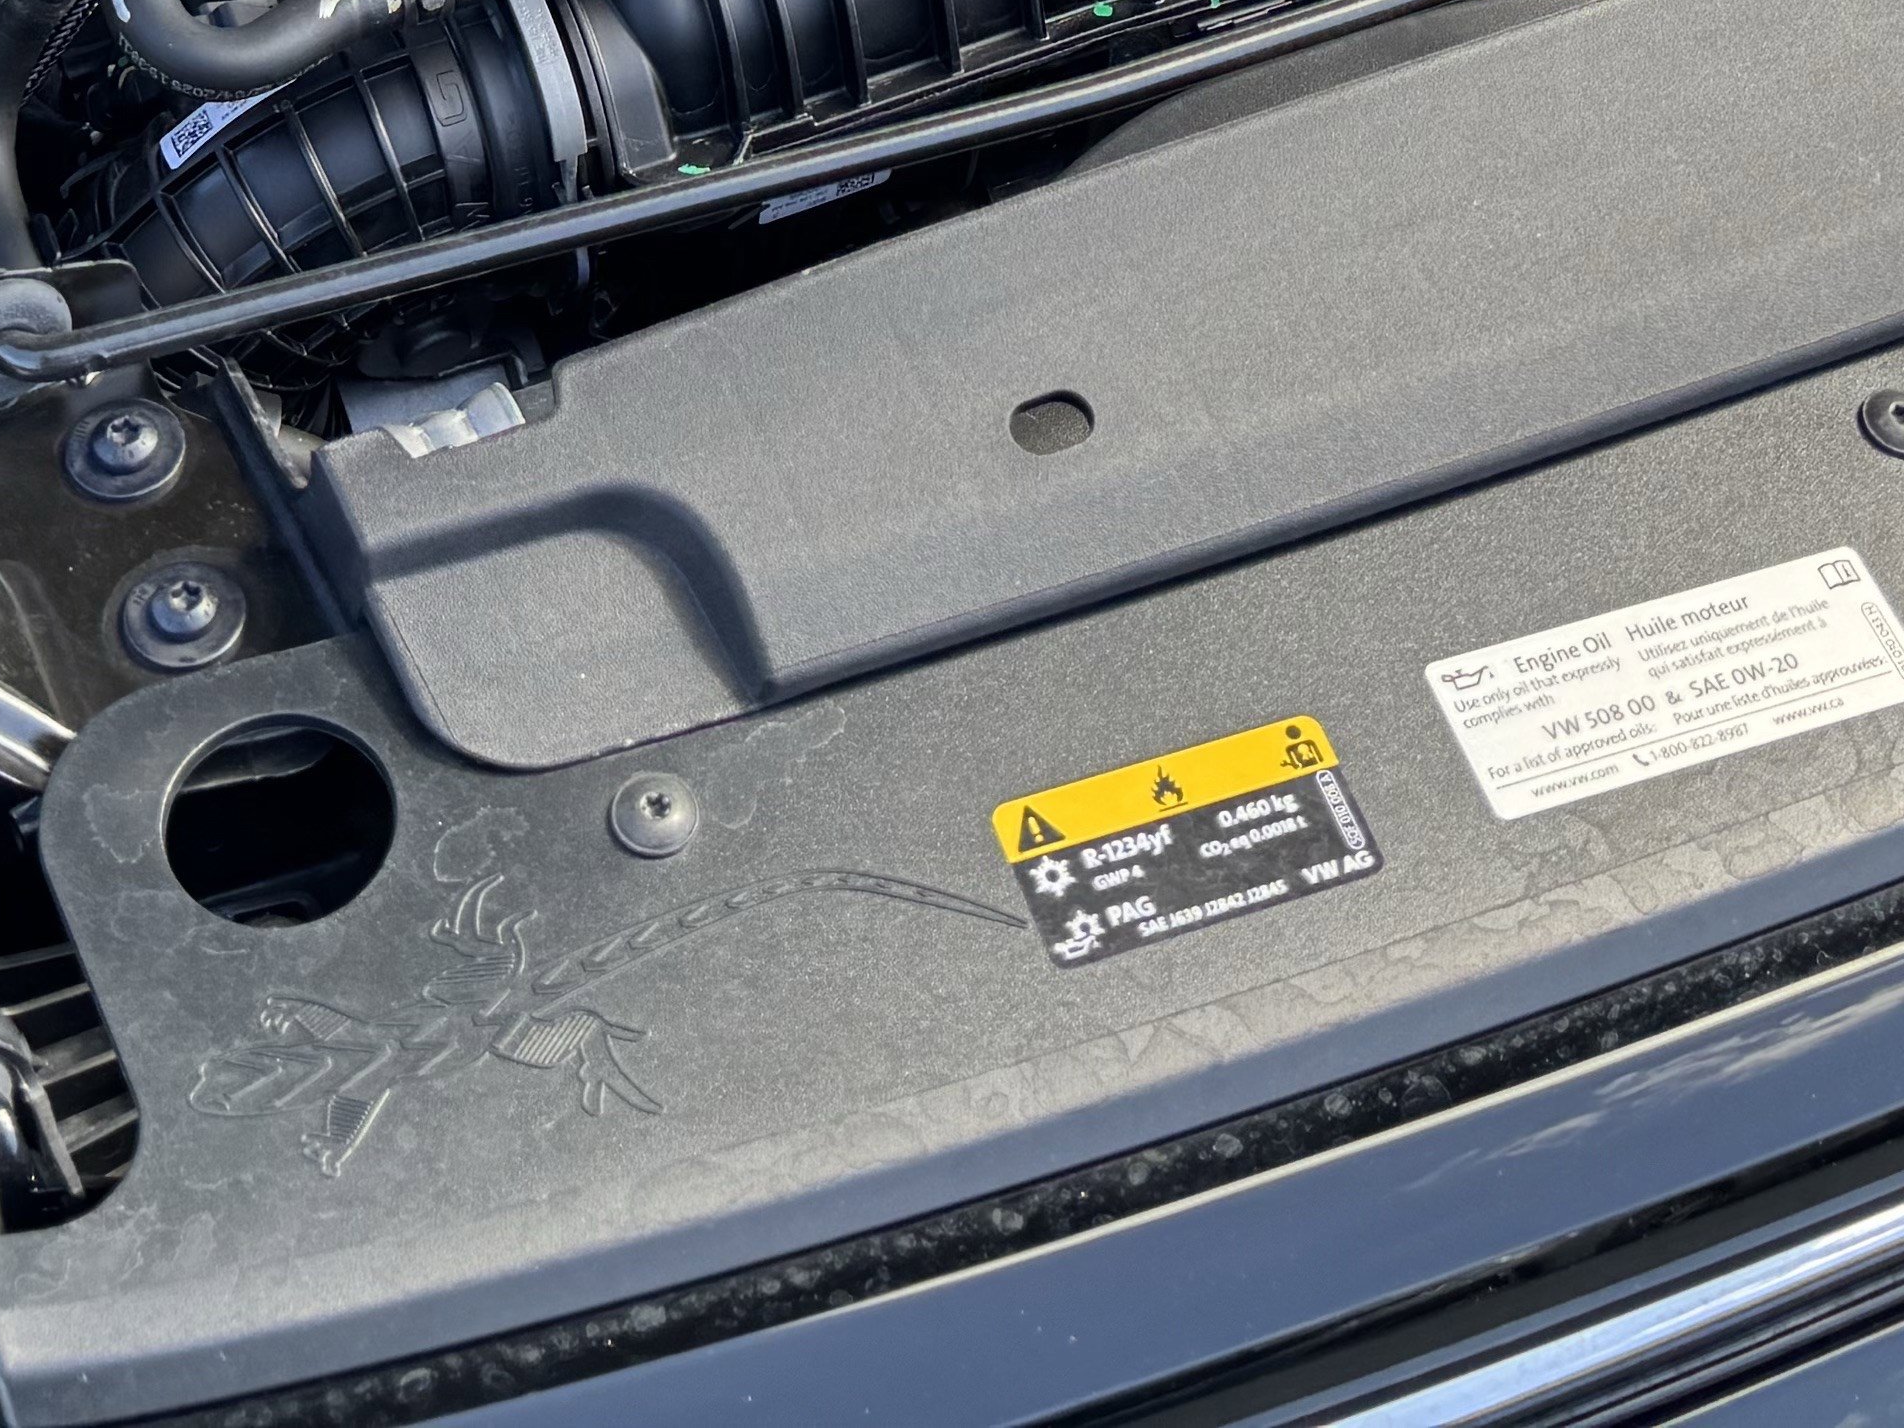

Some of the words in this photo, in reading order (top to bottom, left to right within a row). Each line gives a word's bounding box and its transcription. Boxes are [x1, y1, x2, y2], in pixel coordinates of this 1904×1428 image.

[1625, 616, 1678, 641] Huile
[1681, 597, 1748, 626] moteur
[1638, 640, 1688, 661] Utilisez
[1690, 616, 1770, 650] uniquement
[1772, 611, 1788, 624] de
[1513, 646, 1581, 673] Engine
[1583, 632, 1611, 653] Oil
[1648, 661, 1670, 680] qui
[1672, 647, 1724, 670] satisfait
[1454, 699, 1480, 712] Use
[1482, 688, 1510, 709] only
[1513, 681, 1530, 696] oil
[1530, 671, 1559, 691] that
[1562, 656, 1620, 682] expressly
[1542, 715, 1580, 739] VW
[1585, 704, 1623, 729] 508
[1622, 695, 1655, 718] 00
[1665, 691, 1683, 705] &
[1689, 673, 1729, 698] SAE
[1731, 654, 1798, 685] 0W-20
[1463, 706, 1521, 729] complies
[1520, 694, 1555, 713] with
[1673, 709, 1704, 725] Pour
[1706, 701, 1732, 715] une
[1731, 693, 1760, 707] liste
[1488, 766, 1510, 779] For
[1514, 763, 1522, 773] a
[1522, 754, 1546, 769] list
[1547, 746, 1561, 763] of
[1565, 733, 1622, 758] approved
[1531, 765, 1619, 797] www.vw.com
[1773, 698, 1844, 724] www.vw.ca
[1217, 799, 1272, 828] 0.460
[1270, 794, 1300, 813] kg
[1081, 824, 1172, 869] R-1234yf
[1092, 868, 1132, 890] GWP
[1301, 860, 1339, 884] VW
[1343, 850, 1375, 874] AG
[1105, 896, 1156, 927] PAG
[1137, 916, 1169, 937] SAE
